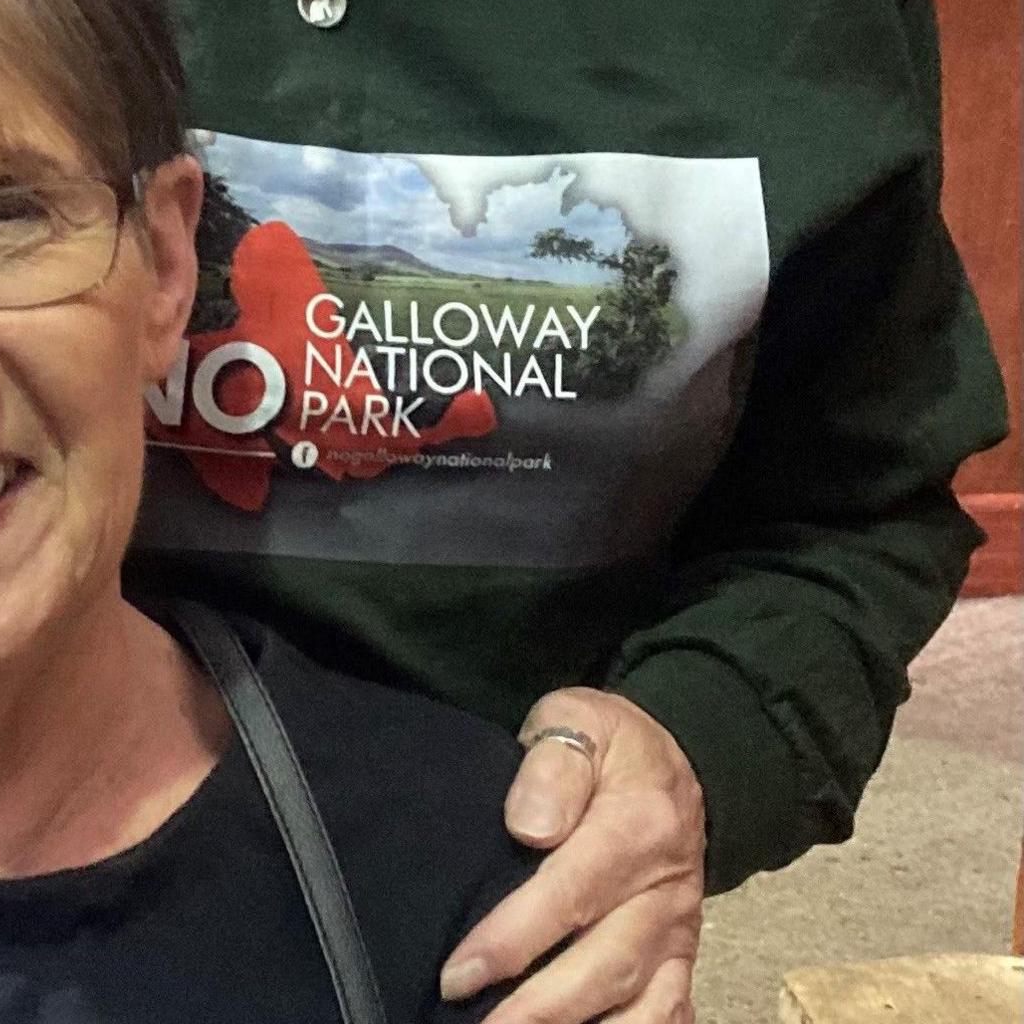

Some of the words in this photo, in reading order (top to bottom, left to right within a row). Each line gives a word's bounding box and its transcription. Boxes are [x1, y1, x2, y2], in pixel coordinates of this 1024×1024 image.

[305, 293, 602, 350] GALLOWAY
[304, 340, 578, 399] NATIONAL
[299, 389, 425, 439] PARK
